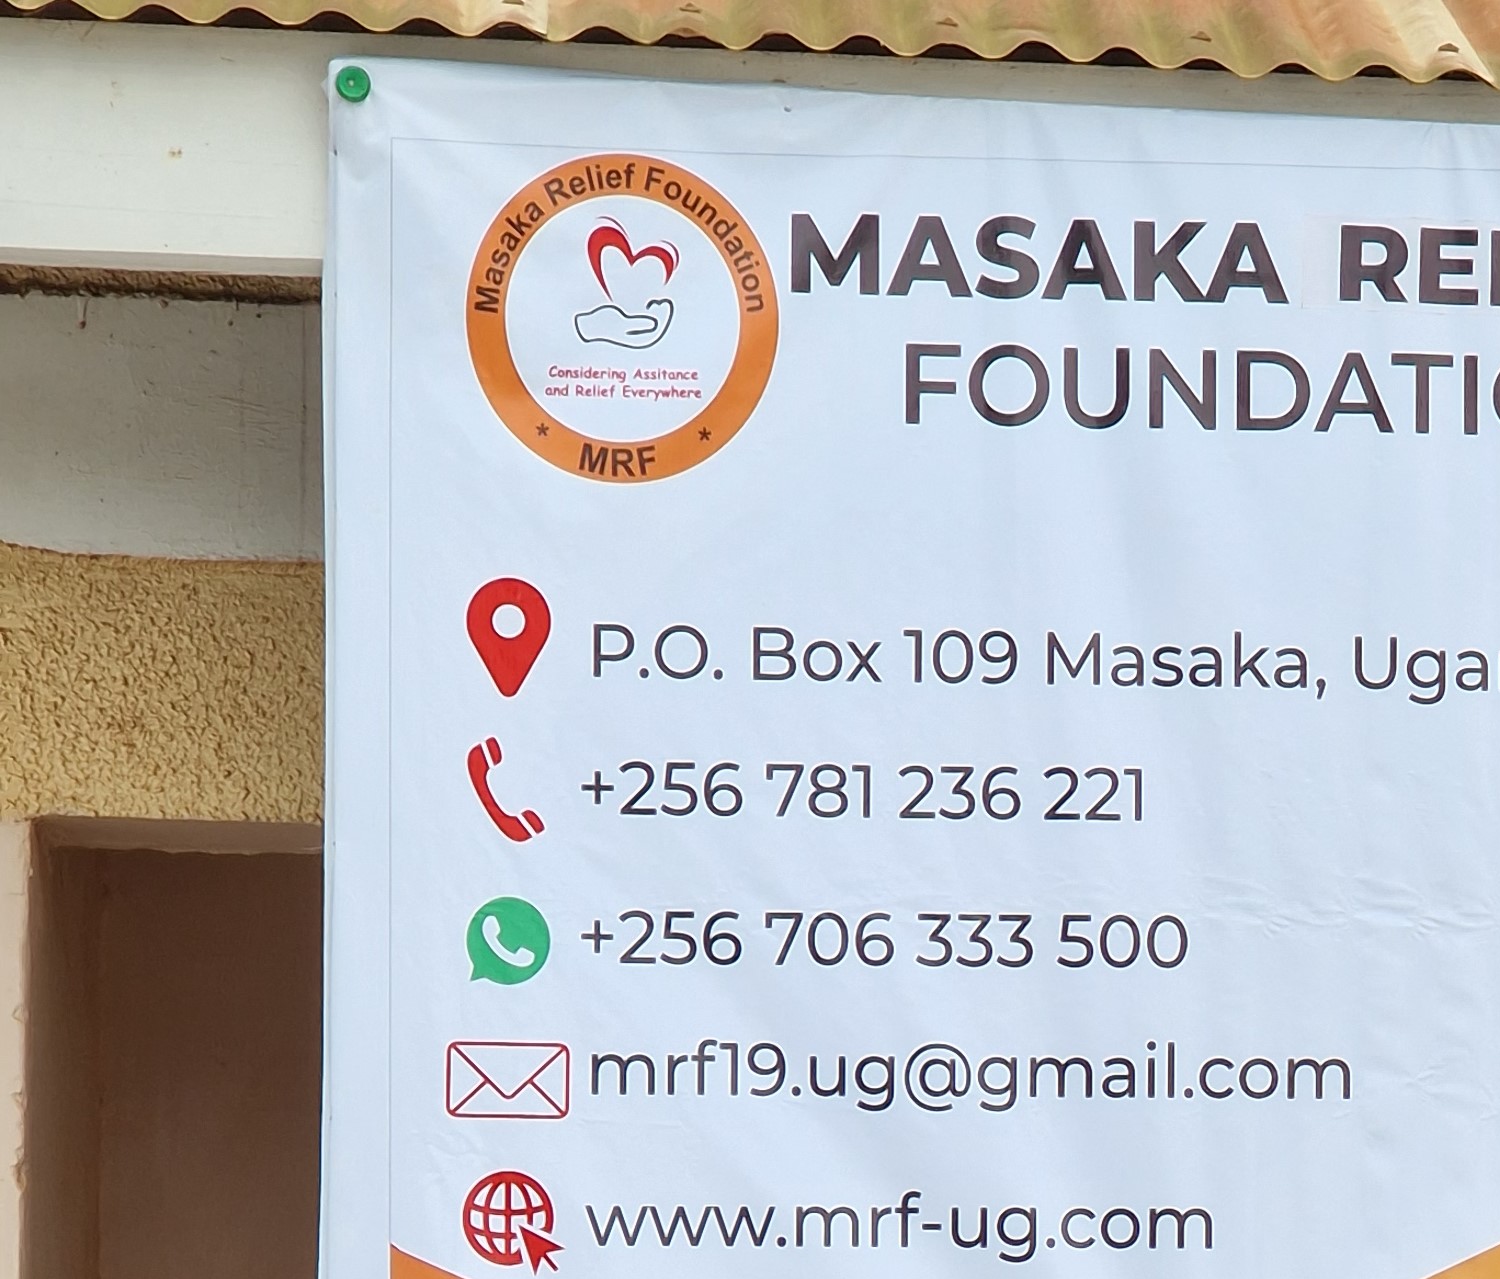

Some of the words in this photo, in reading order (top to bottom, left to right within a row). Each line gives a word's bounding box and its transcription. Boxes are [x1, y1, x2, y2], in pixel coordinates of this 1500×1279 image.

[474, 201, 543, 315] Masaka
[544, 162, 637, 208] Relief
[643, 165, 765, 315] Foundation
[791, 213, 1289, 305] MASAKA
[544, 385, 570, 398] and
[574, 384, 617, 399] Relief
[620, 386, 703, 402] Everywhere
[548, 365, 627, 383] Considering
[632, 367, 700, 382] Assitance
[578, 444, 657, 478] MRF
[591, 622, 723, 681] P.O.
[752, 626, 883, 684] Box
[903, 629, 1019, 686] 109
[1046, 630, 1327, 701] Masaka,
[580, 761, 743, 818] +256
[766, 763, 872, 819] 781
[898, 765, 1022, 822] 236
[1043, 766, 1143, 822] 221
[580, 910, 743, 967] +256
[765, 911, 896, 968] 706
[916, 912, 1035, 969] 333
[1056, 914, 1189, 970] 500
[590, 1038, 1352, 1113] mrf19.ug@gmail.com
[585, 1190, 1214, 1264] www.mrf-ug.com
